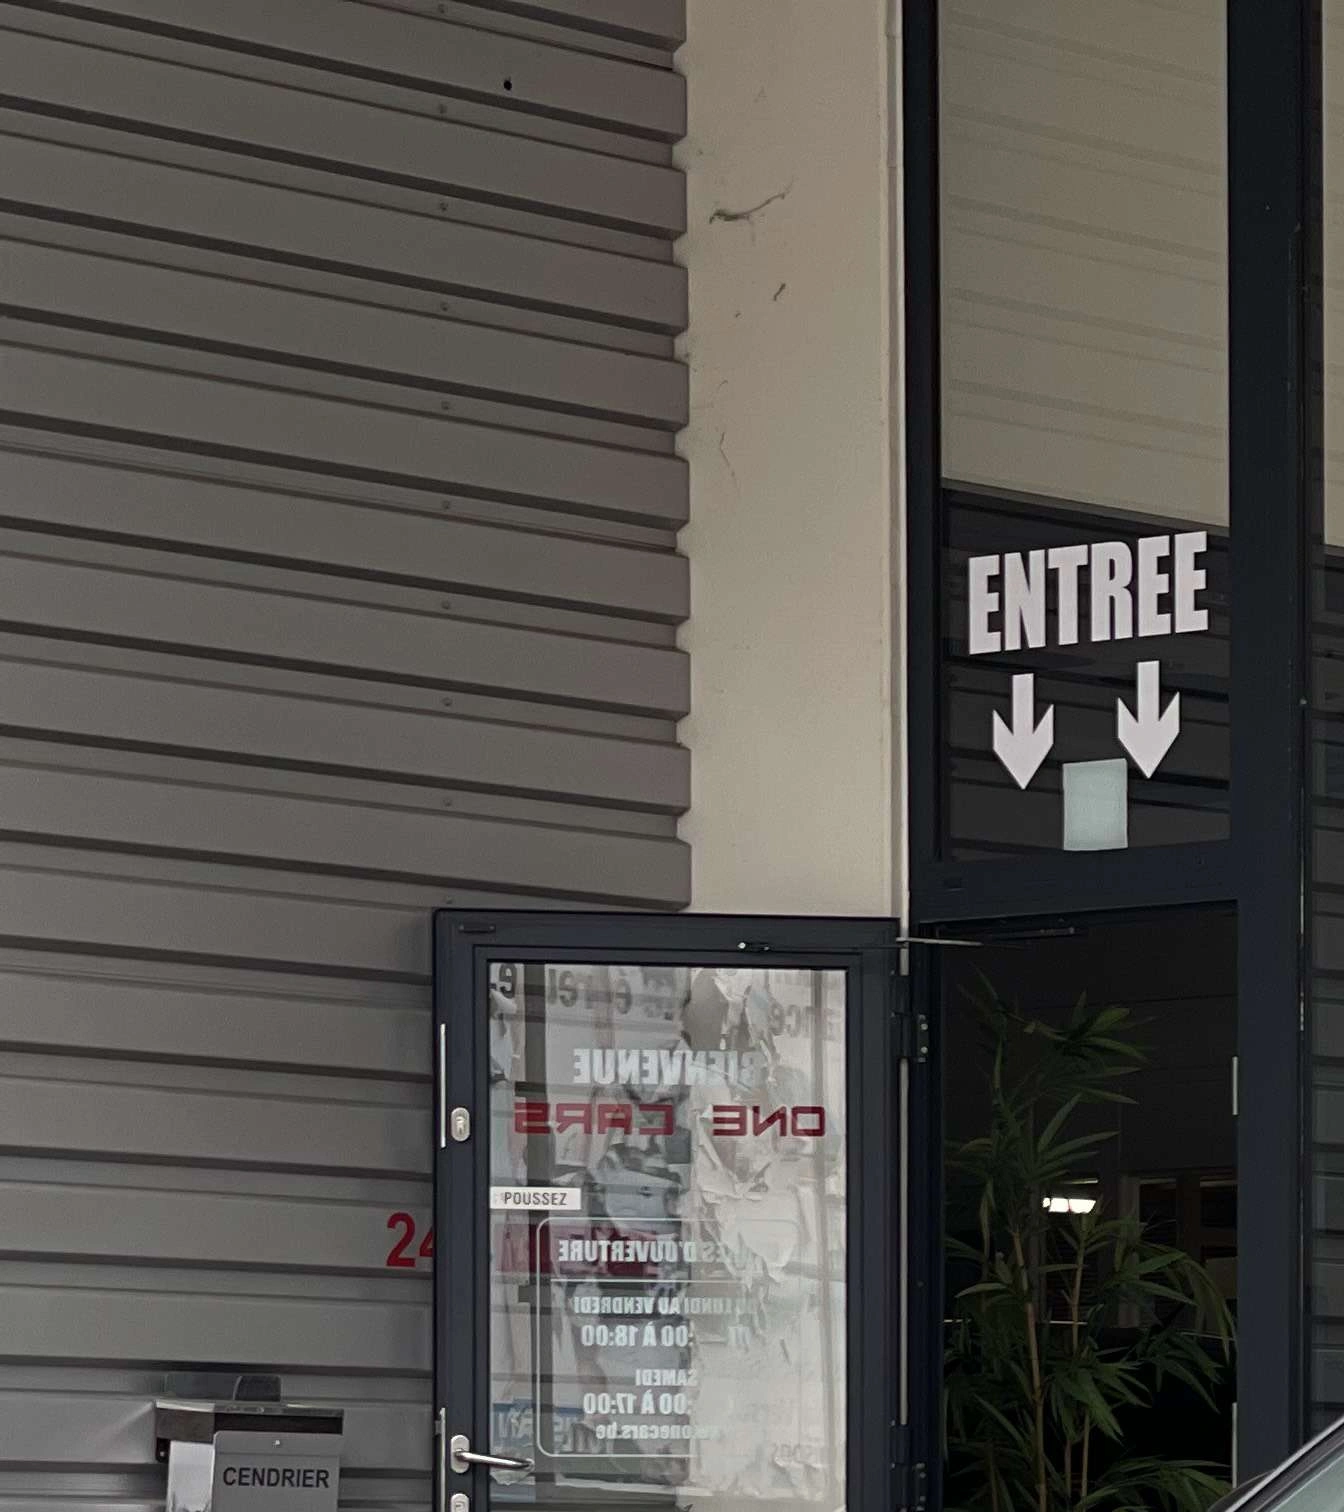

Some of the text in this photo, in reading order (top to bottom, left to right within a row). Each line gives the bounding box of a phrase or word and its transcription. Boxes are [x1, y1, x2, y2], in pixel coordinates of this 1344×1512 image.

[968, 531, 1208, 655] ENTREE
[503, 1191, 567, 1206] POUSSEZ
[222, 1466, 330, 1489] CENDRIER
